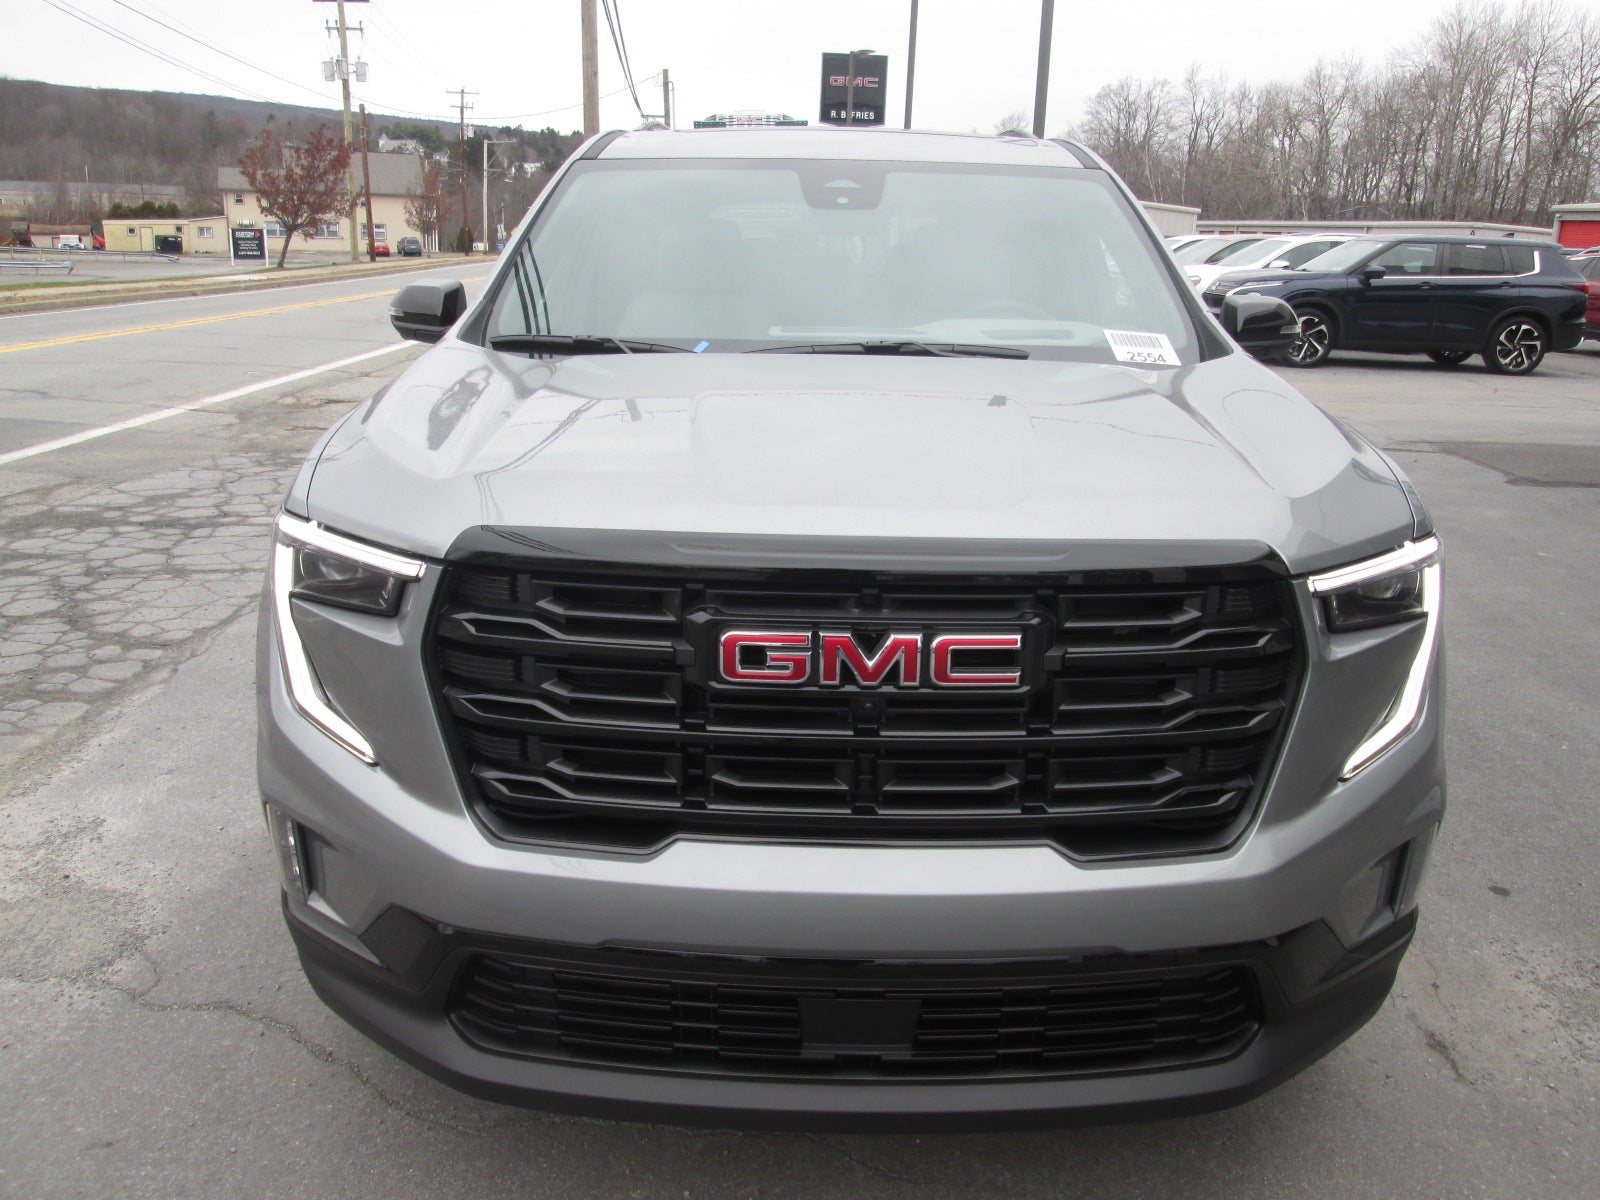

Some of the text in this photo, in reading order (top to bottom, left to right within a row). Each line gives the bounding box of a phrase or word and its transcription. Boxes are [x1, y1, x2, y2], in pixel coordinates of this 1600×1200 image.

[829, 76, 879, 87] GMC
[830, 110, 839, 119] R.
[851, 111, 875, 120] FRIES
[1126, 351, 1167, 364] 2554
[720, 630, 1022, 687] GMC
